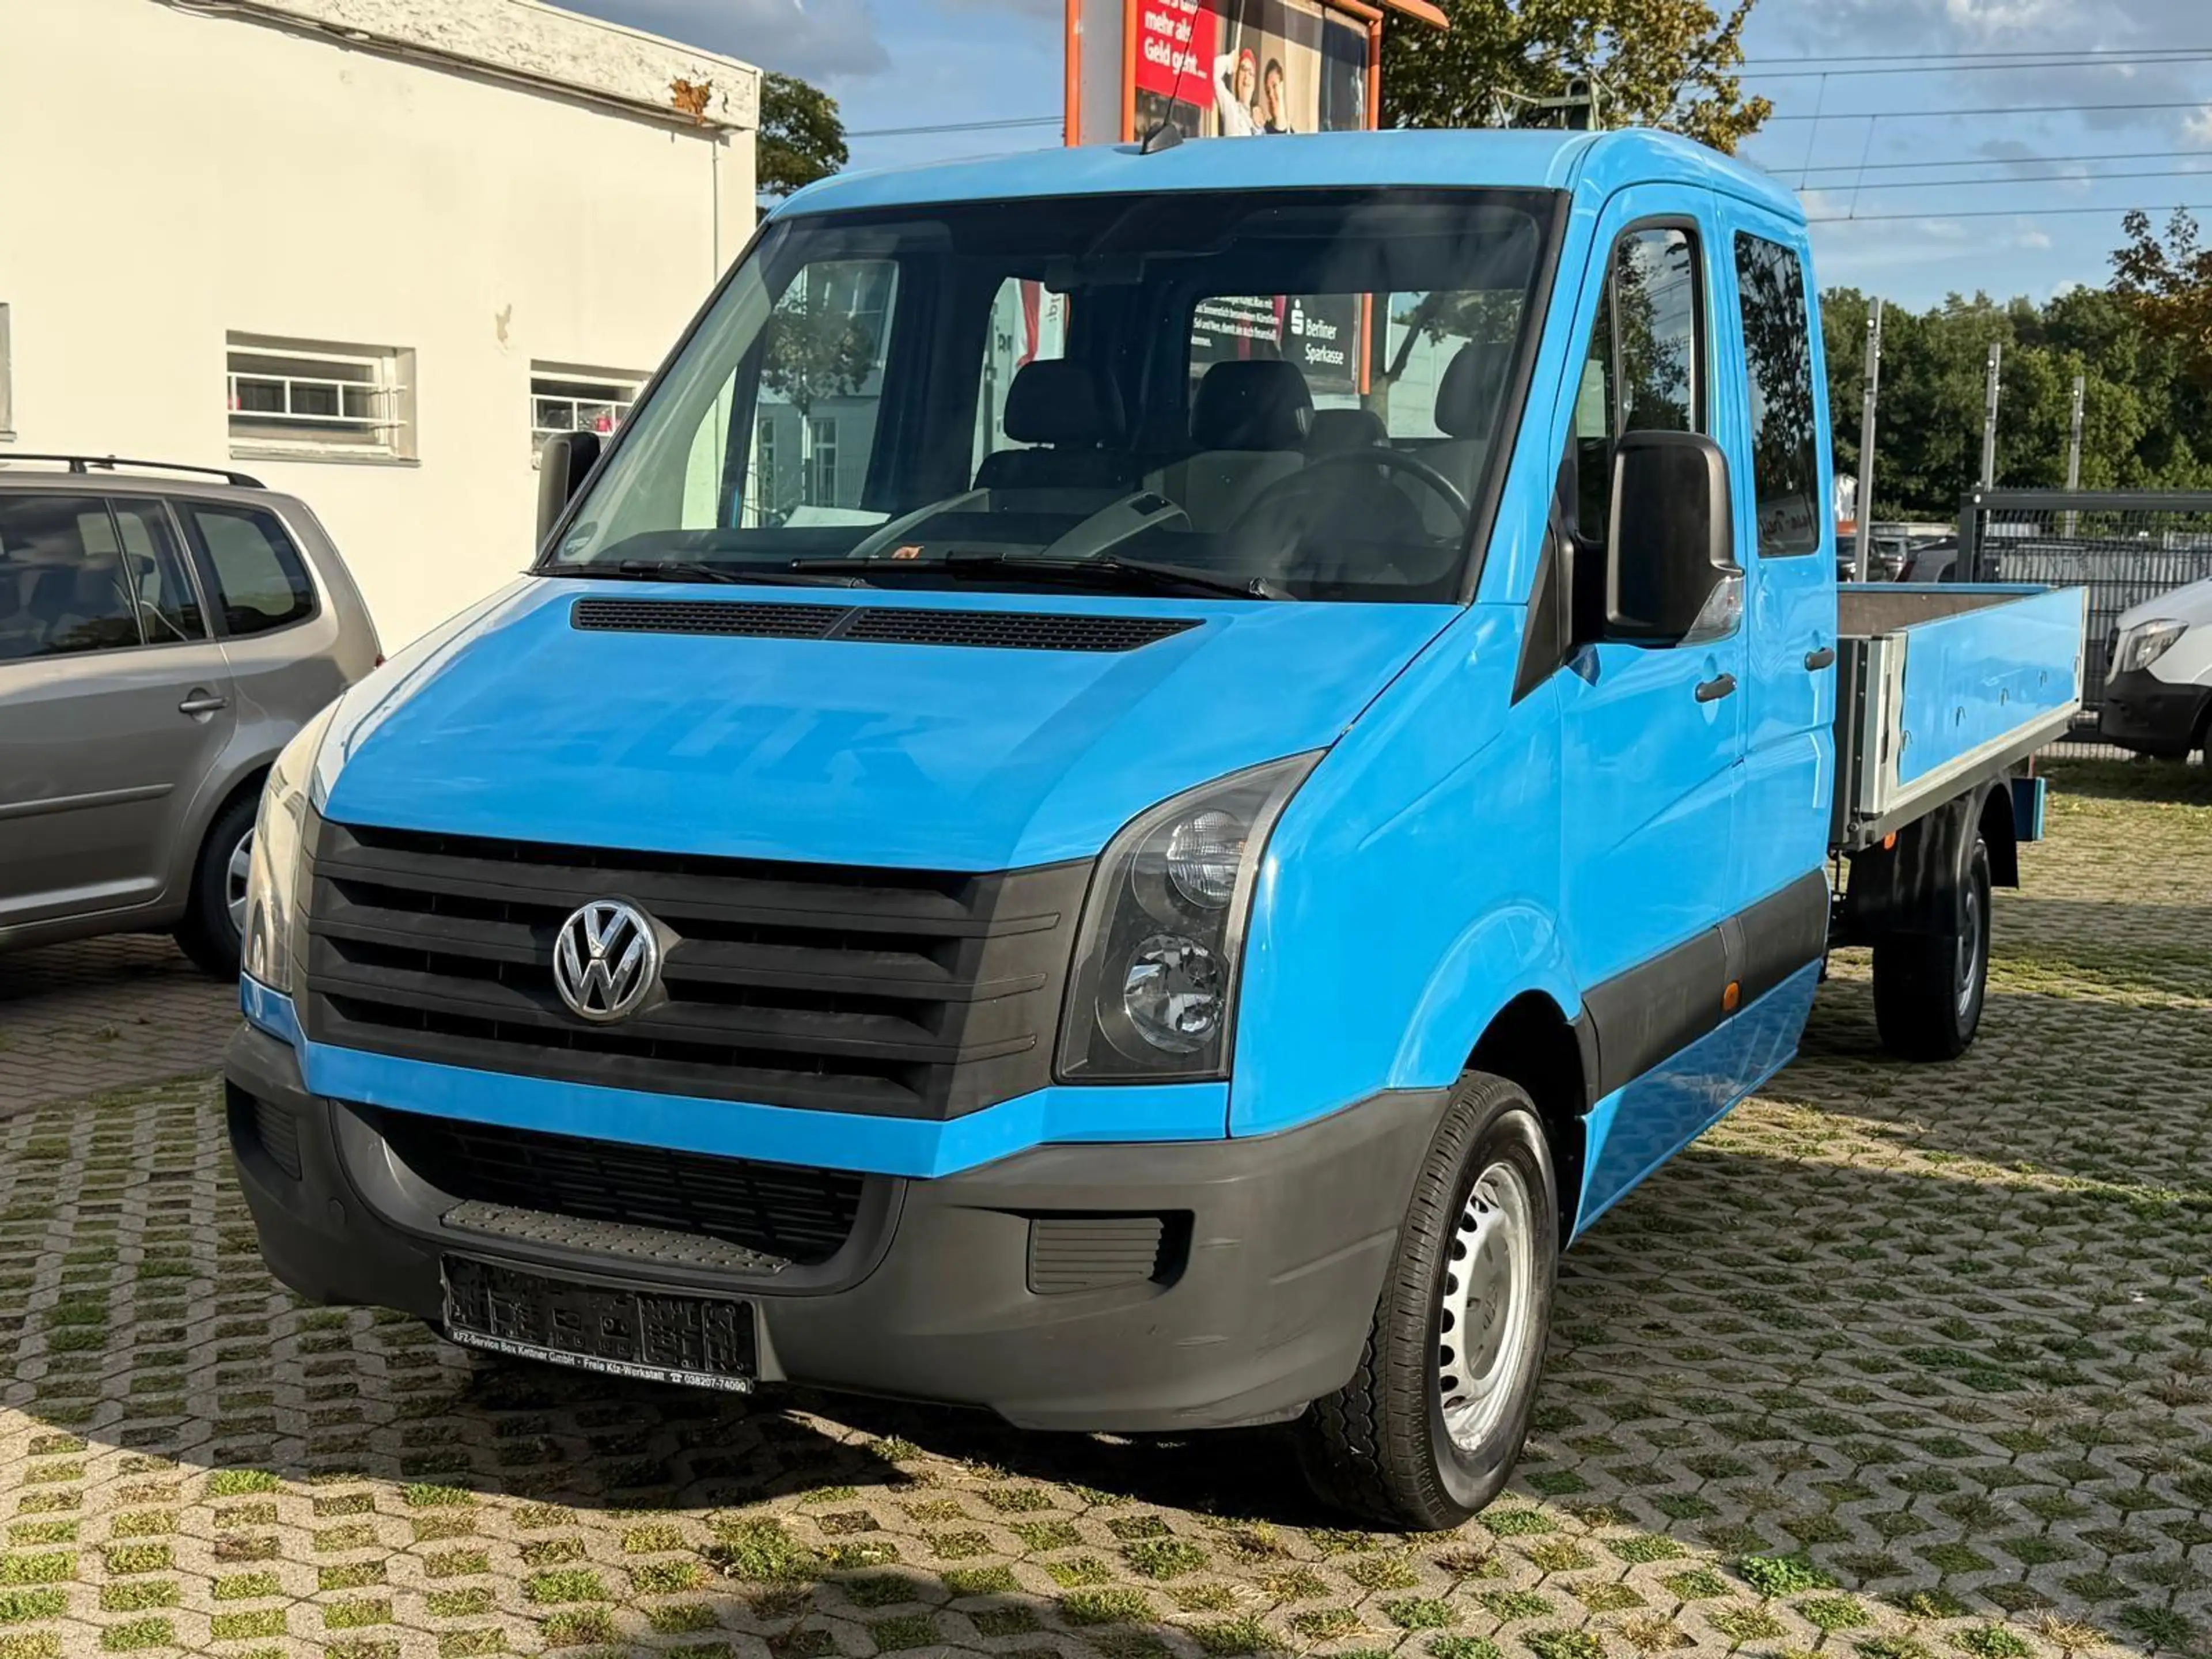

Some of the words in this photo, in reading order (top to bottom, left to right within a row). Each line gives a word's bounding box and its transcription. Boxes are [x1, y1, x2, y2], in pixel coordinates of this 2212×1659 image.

[1145, 10, 1174, 36] mehr
[1175, 18, 1191, 42] als
[1145, 36, 1171, 67] Geld
[1306, 318, 1337, 339] Berliner
[1305, 343, 1343, 365] Sparkasse
[558, 902, 653, 1015] VW
[453, 1330, 499, 1350] KFZ-Service
[548, 1352, 574, 1365] GmbH
[584, 1359, 605, 1371] Freie
[607, 1363, 664, 1381] Kfz-Werkstatt
